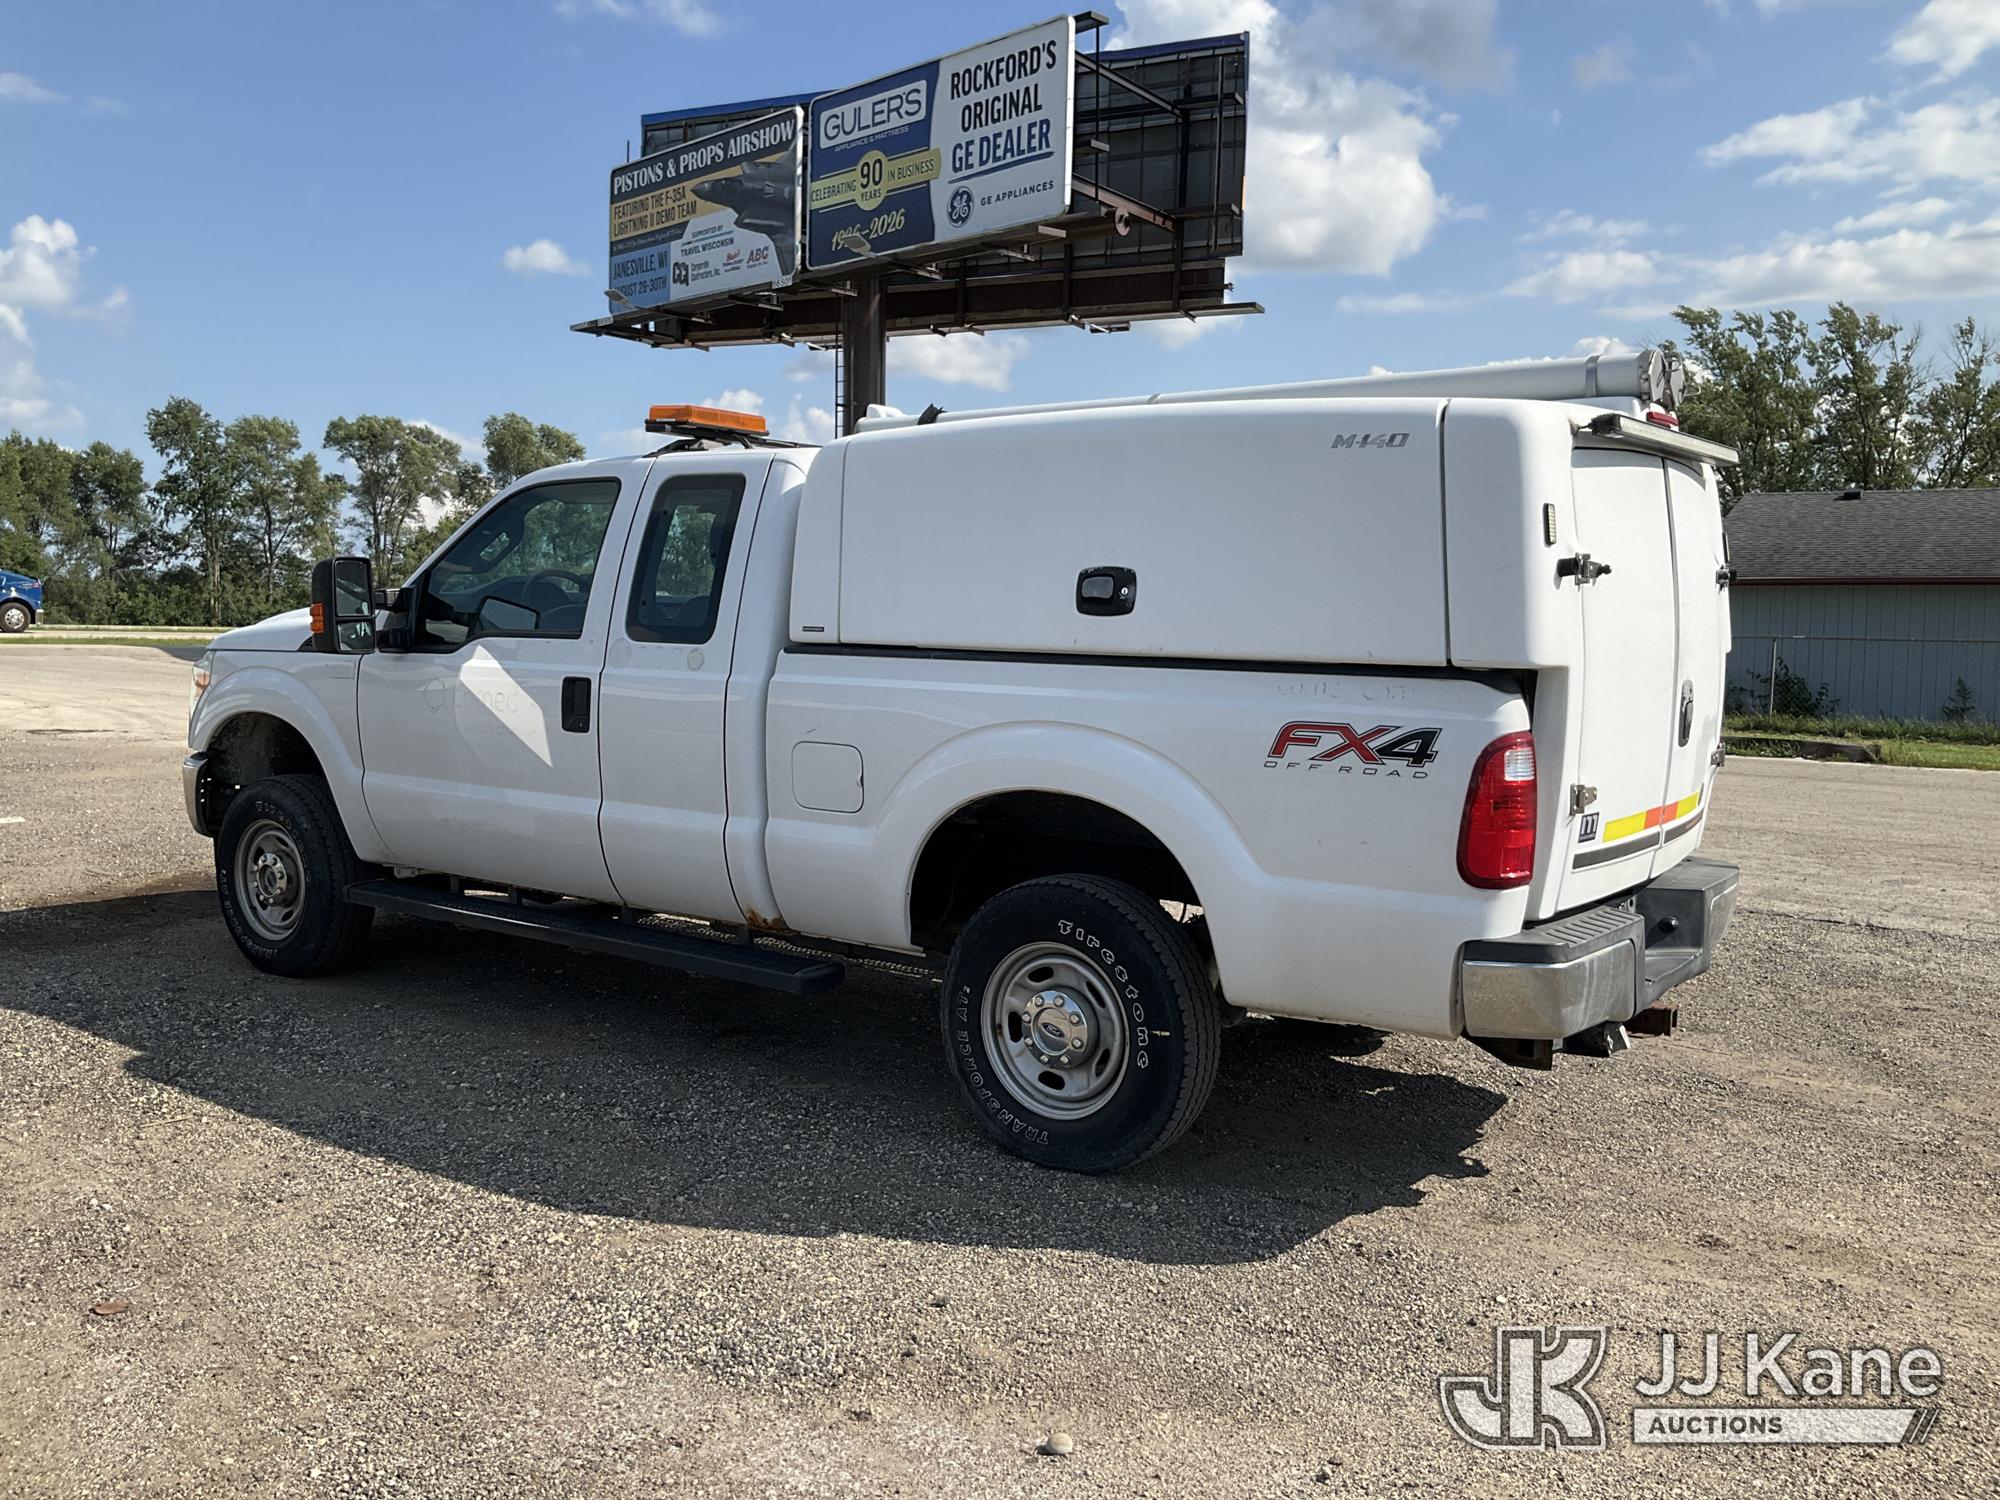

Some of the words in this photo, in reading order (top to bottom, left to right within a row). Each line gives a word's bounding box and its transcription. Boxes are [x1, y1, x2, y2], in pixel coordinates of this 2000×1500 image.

[950, 40, 1056, 100] ROCKFORD'S
[824, 88, 922, 141] GULER'S
[961, 83, 1043, 133] ORIGINAL
[834, 138, 869, 152] APPLIANCE
[874, 126, 909, 141] MATTRESS
[952, 140, 975, 174] GE
[978, 118, 1051, 168] DEALER
[613, 162, 664, 195] PISTONS
[666, 157, 677, 179] &
[679, 142, 724, 174] PROPS
[727, 119, 795, 159] AIRSHOW
[887, 169, 896, 183] IN
[897, 158, 934, 179] BUSINESS
[860, 158, 883, 190] 90
[614, 197, 649, 220] FEATURING
[651, 192, 664, 209] THE
[665, 185, 686, 204] F-35A
[811, 180, 857, 202] CELEBRATING
[860, 188, 882, 203] YEARS
[980, 195, 992, 206] GE
[995, 180, 1054, 203] APPLIANCES
[613, 214, 648, 237] LIGHTNING
[656, 206, 676, 226] DEMO
[677, 200, 697, 219] TEAM
[680, 244, 701, 257] TRAVEL
[701, 237, 735, 252] WISCONSIN
[746, 246, 769, 264] ABC
[613, 254, 656, 280] JANESVILLE,
[657, 250, 668, 269] WI
[1267, 720, 1442, 768] FX4
[1264, 761, 1323, 772] OFF
[1338, 766, 1429, 779] ROAD
[1058, 919, 1149, 1069] Firestone
[957, 1029, 1049, 1145] TRANSFORCE
